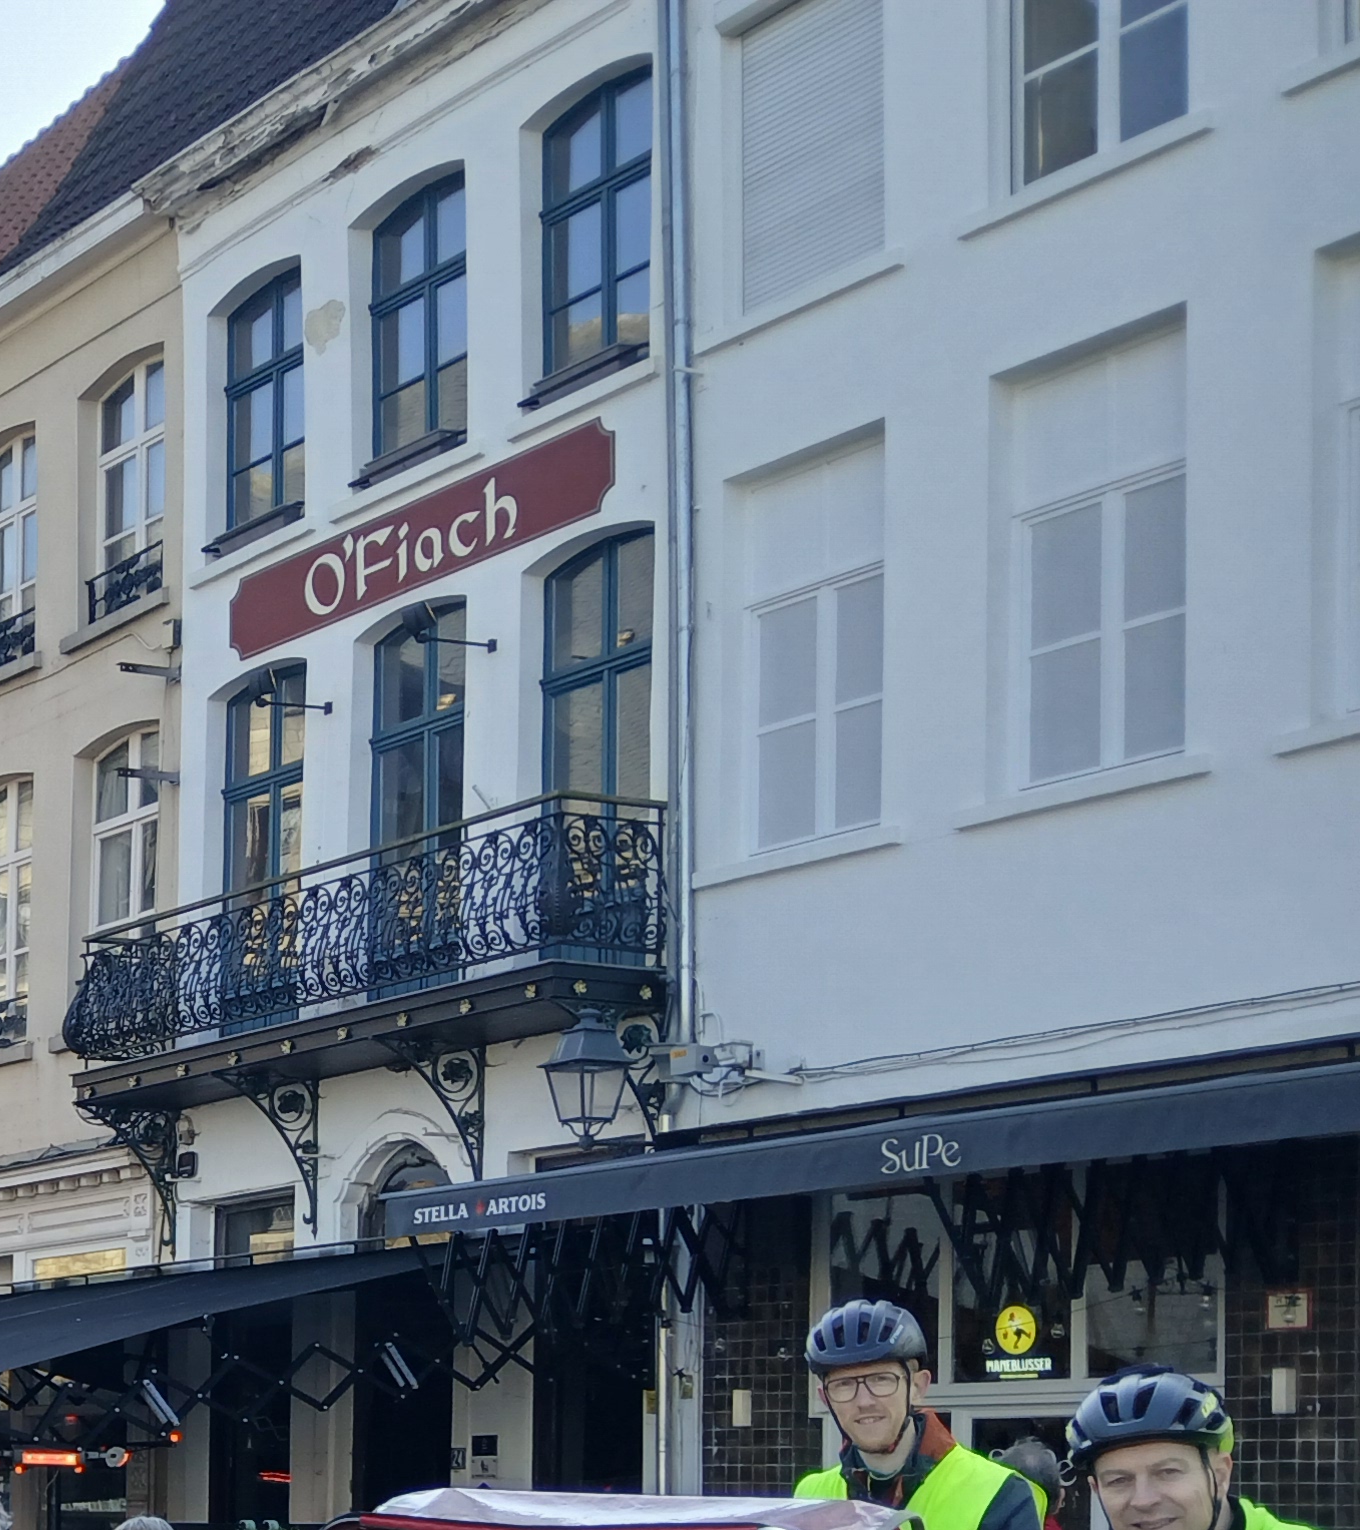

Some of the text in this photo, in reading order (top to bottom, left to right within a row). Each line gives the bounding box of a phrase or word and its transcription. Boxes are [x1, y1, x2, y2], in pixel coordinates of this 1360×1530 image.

[303, 476, 518, 616] O'Fiach
[413, 1192, 547, 1225] STELLA ARTOIS
[985, 1357, 1052, 1373] MANEBLUSSER
